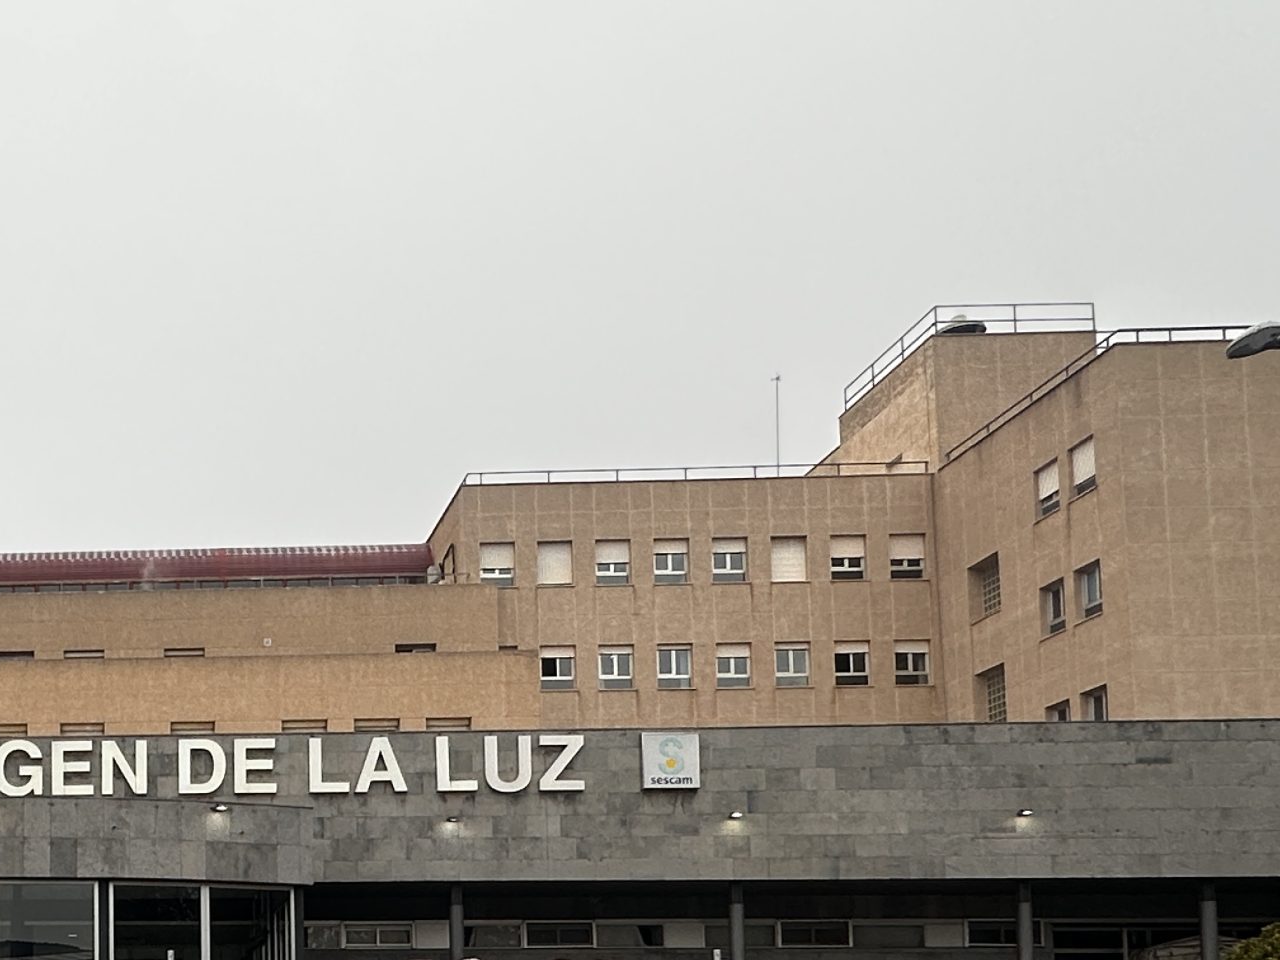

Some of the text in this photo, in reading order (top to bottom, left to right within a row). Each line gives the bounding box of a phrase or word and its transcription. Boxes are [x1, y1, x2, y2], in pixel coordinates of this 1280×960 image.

[177, 737, 278, 795] DE
[308, 736, 408, 794] LA
[435, 735, 586, 793] LUZ
[650, 776, 694, 785] sescam
